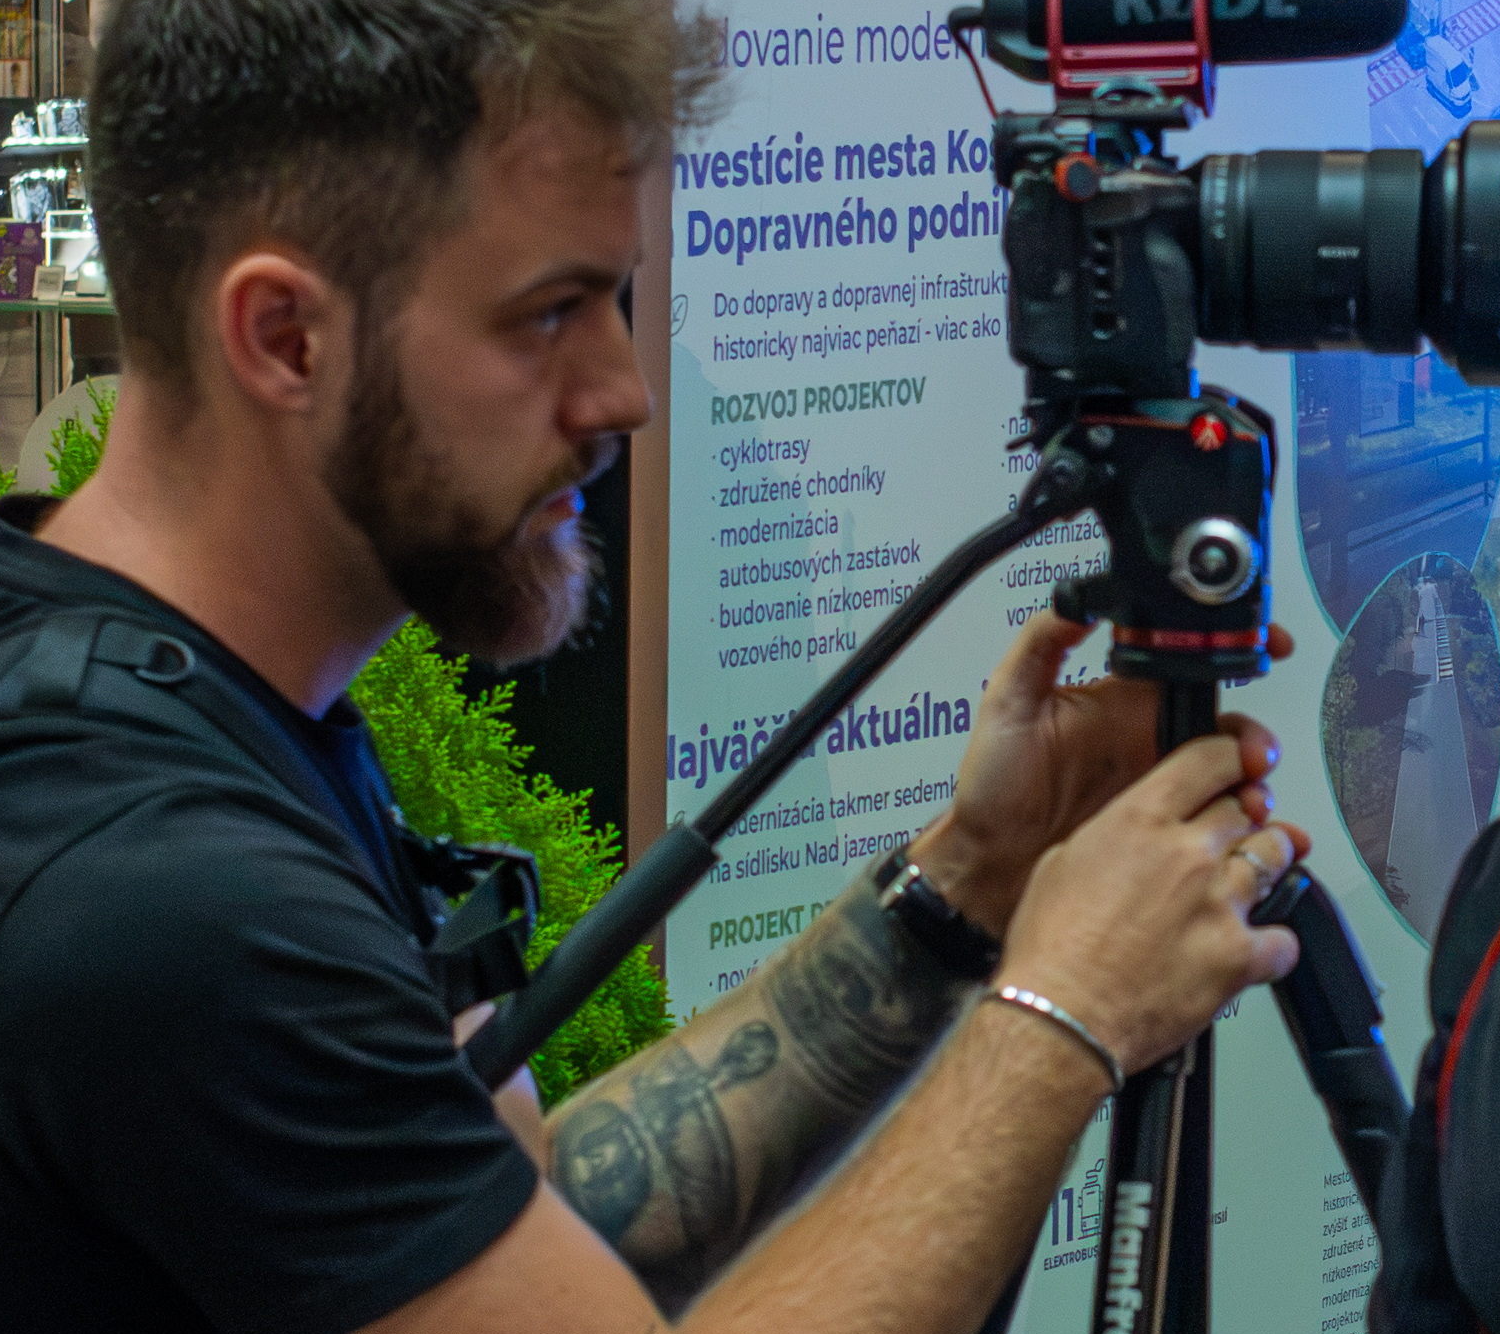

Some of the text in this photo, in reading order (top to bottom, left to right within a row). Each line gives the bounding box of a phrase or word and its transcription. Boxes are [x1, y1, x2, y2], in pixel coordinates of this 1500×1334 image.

[835, 134, 936, 181] mesta
[687, 196, 898, 266] Dopravného
[714, 292, 739, 317] Do
[743, 285, 814, 319] dopravy
[818, 287, 827, 301] a
[832, 275, 917, 312] dopravnej
[713, 329, 798, 362] historicky
[802, 323, 862, 359] najviac
[866, 318, 922, 354] peňazí
[935, 317, 968, 342] viac
[972, 313, 1001, 338] ako
[711, 376, 927, 426] ROZVOJ PROJEKTOV
[719, 435, 811, 473] cyklotrasy
[719, 464, 886, 508] združené chodníky
[719, 509, 839, 548] modernizácia
[719, 538, 920, 591] autobusových zastávok
[719, 591, 812, 629] budovanie
[719, 627, 856, 670] vozového parku
[827, 691, 971, 756] aktuálna
[830, 787, 889, 830] takmer
[735, 841, 800, 881] sídlisku
[805, 834, 839, 869] Nad
[843, 828, 910, 867] jazerom
[709, 904, 804, 950] PROJEKT
